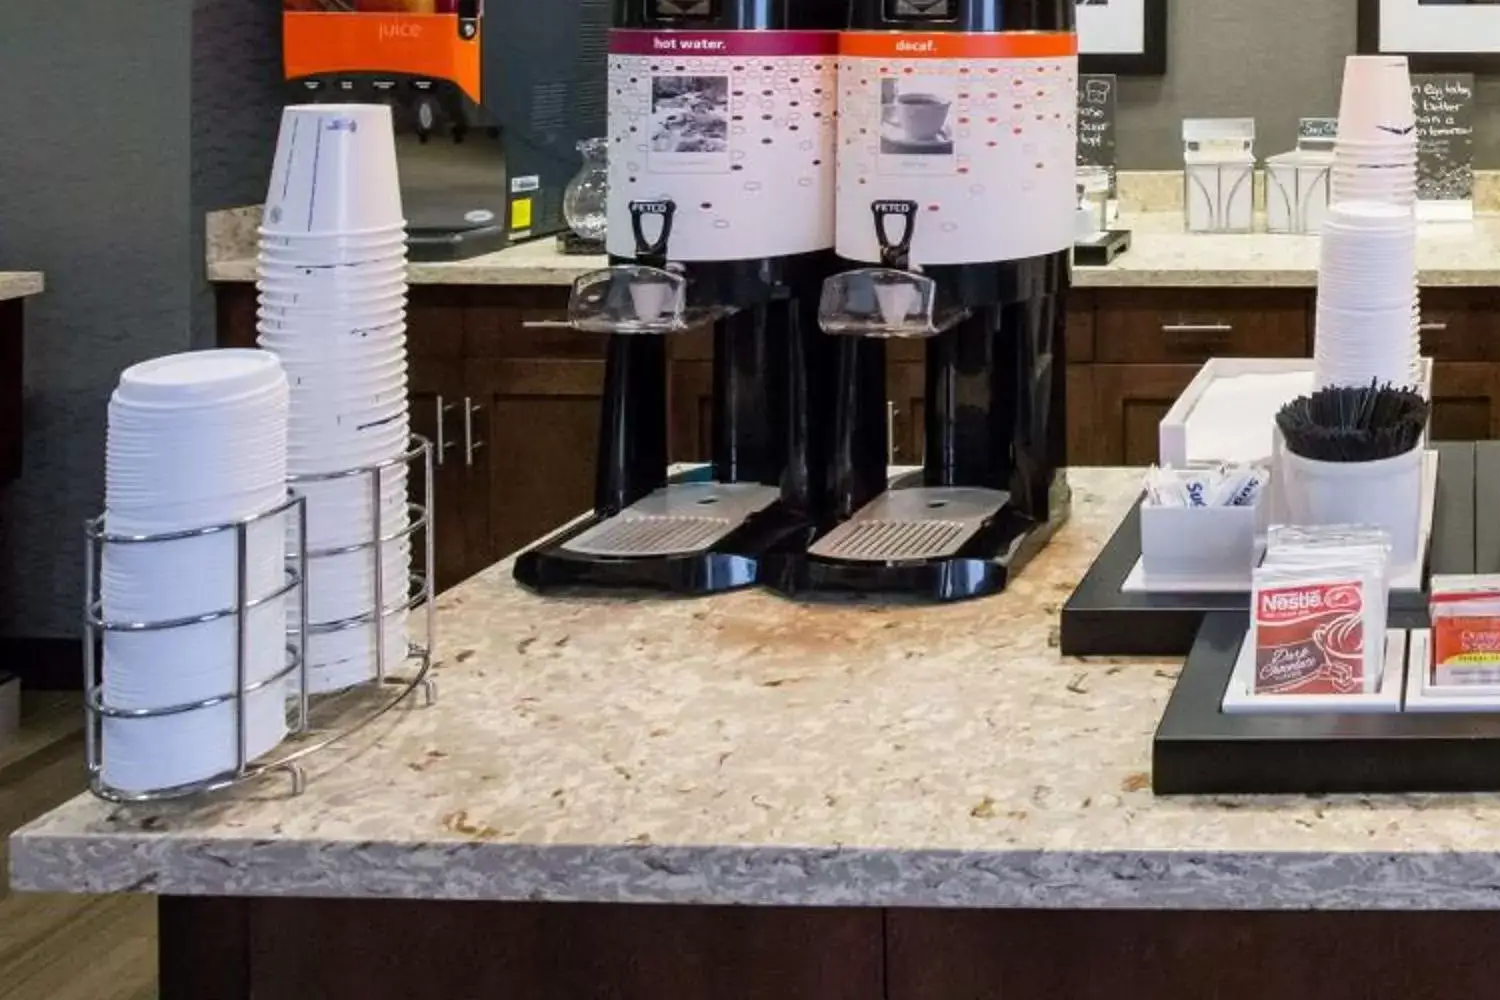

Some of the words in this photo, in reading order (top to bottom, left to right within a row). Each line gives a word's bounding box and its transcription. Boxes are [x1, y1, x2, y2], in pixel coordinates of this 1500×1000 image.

[378, 19, 423, 42] juice
[653, 36, 677, 49] hot
[680, 38, 727, 49] water.
[895, 39, 938, 51] decaf.
[875, 203, 910, 212] FETCO
